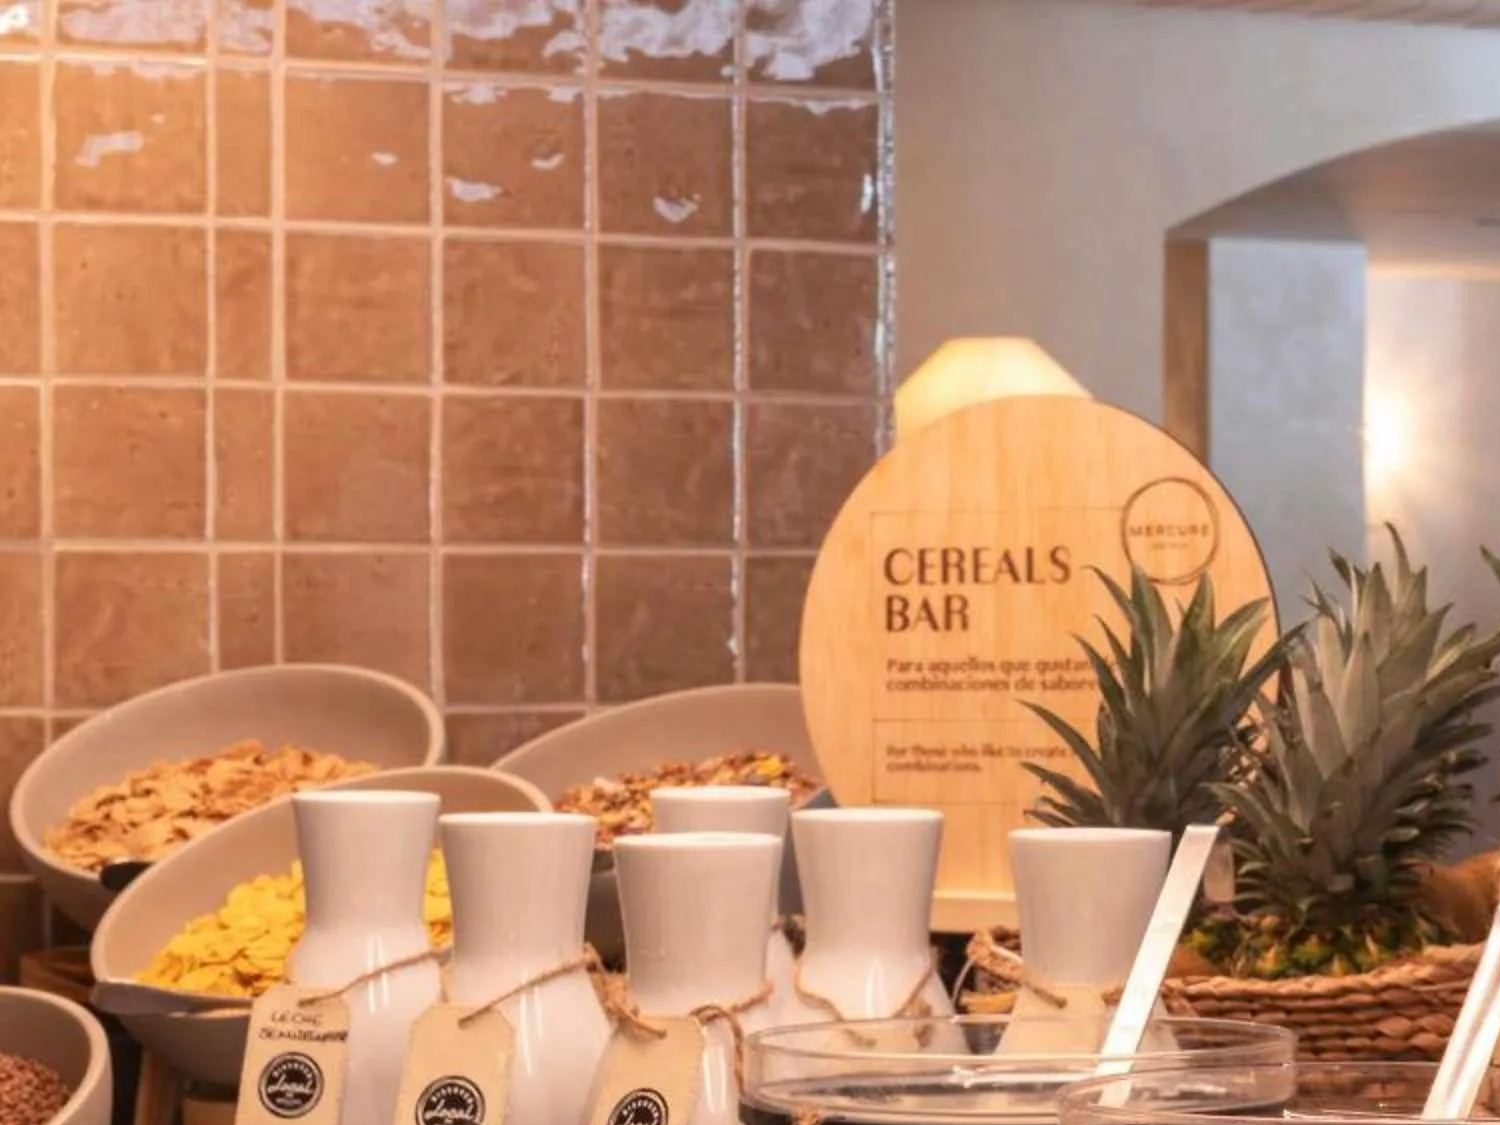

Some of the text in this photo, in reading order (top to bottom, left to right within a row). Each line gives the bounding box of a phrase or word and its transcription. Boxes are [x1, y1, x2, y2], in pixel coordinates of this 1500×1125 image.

[883, 545, 1072, 586] CEREALS
[885, 593, 969, 633] BAR
[886, 658, 923, 674] Para
[928, 656, 995, 678] aquellos
[1001, 659, 1030, 676] que
[886, 676, 1010, 691] combinaciones
[1014, 676, 1034, 691] de
